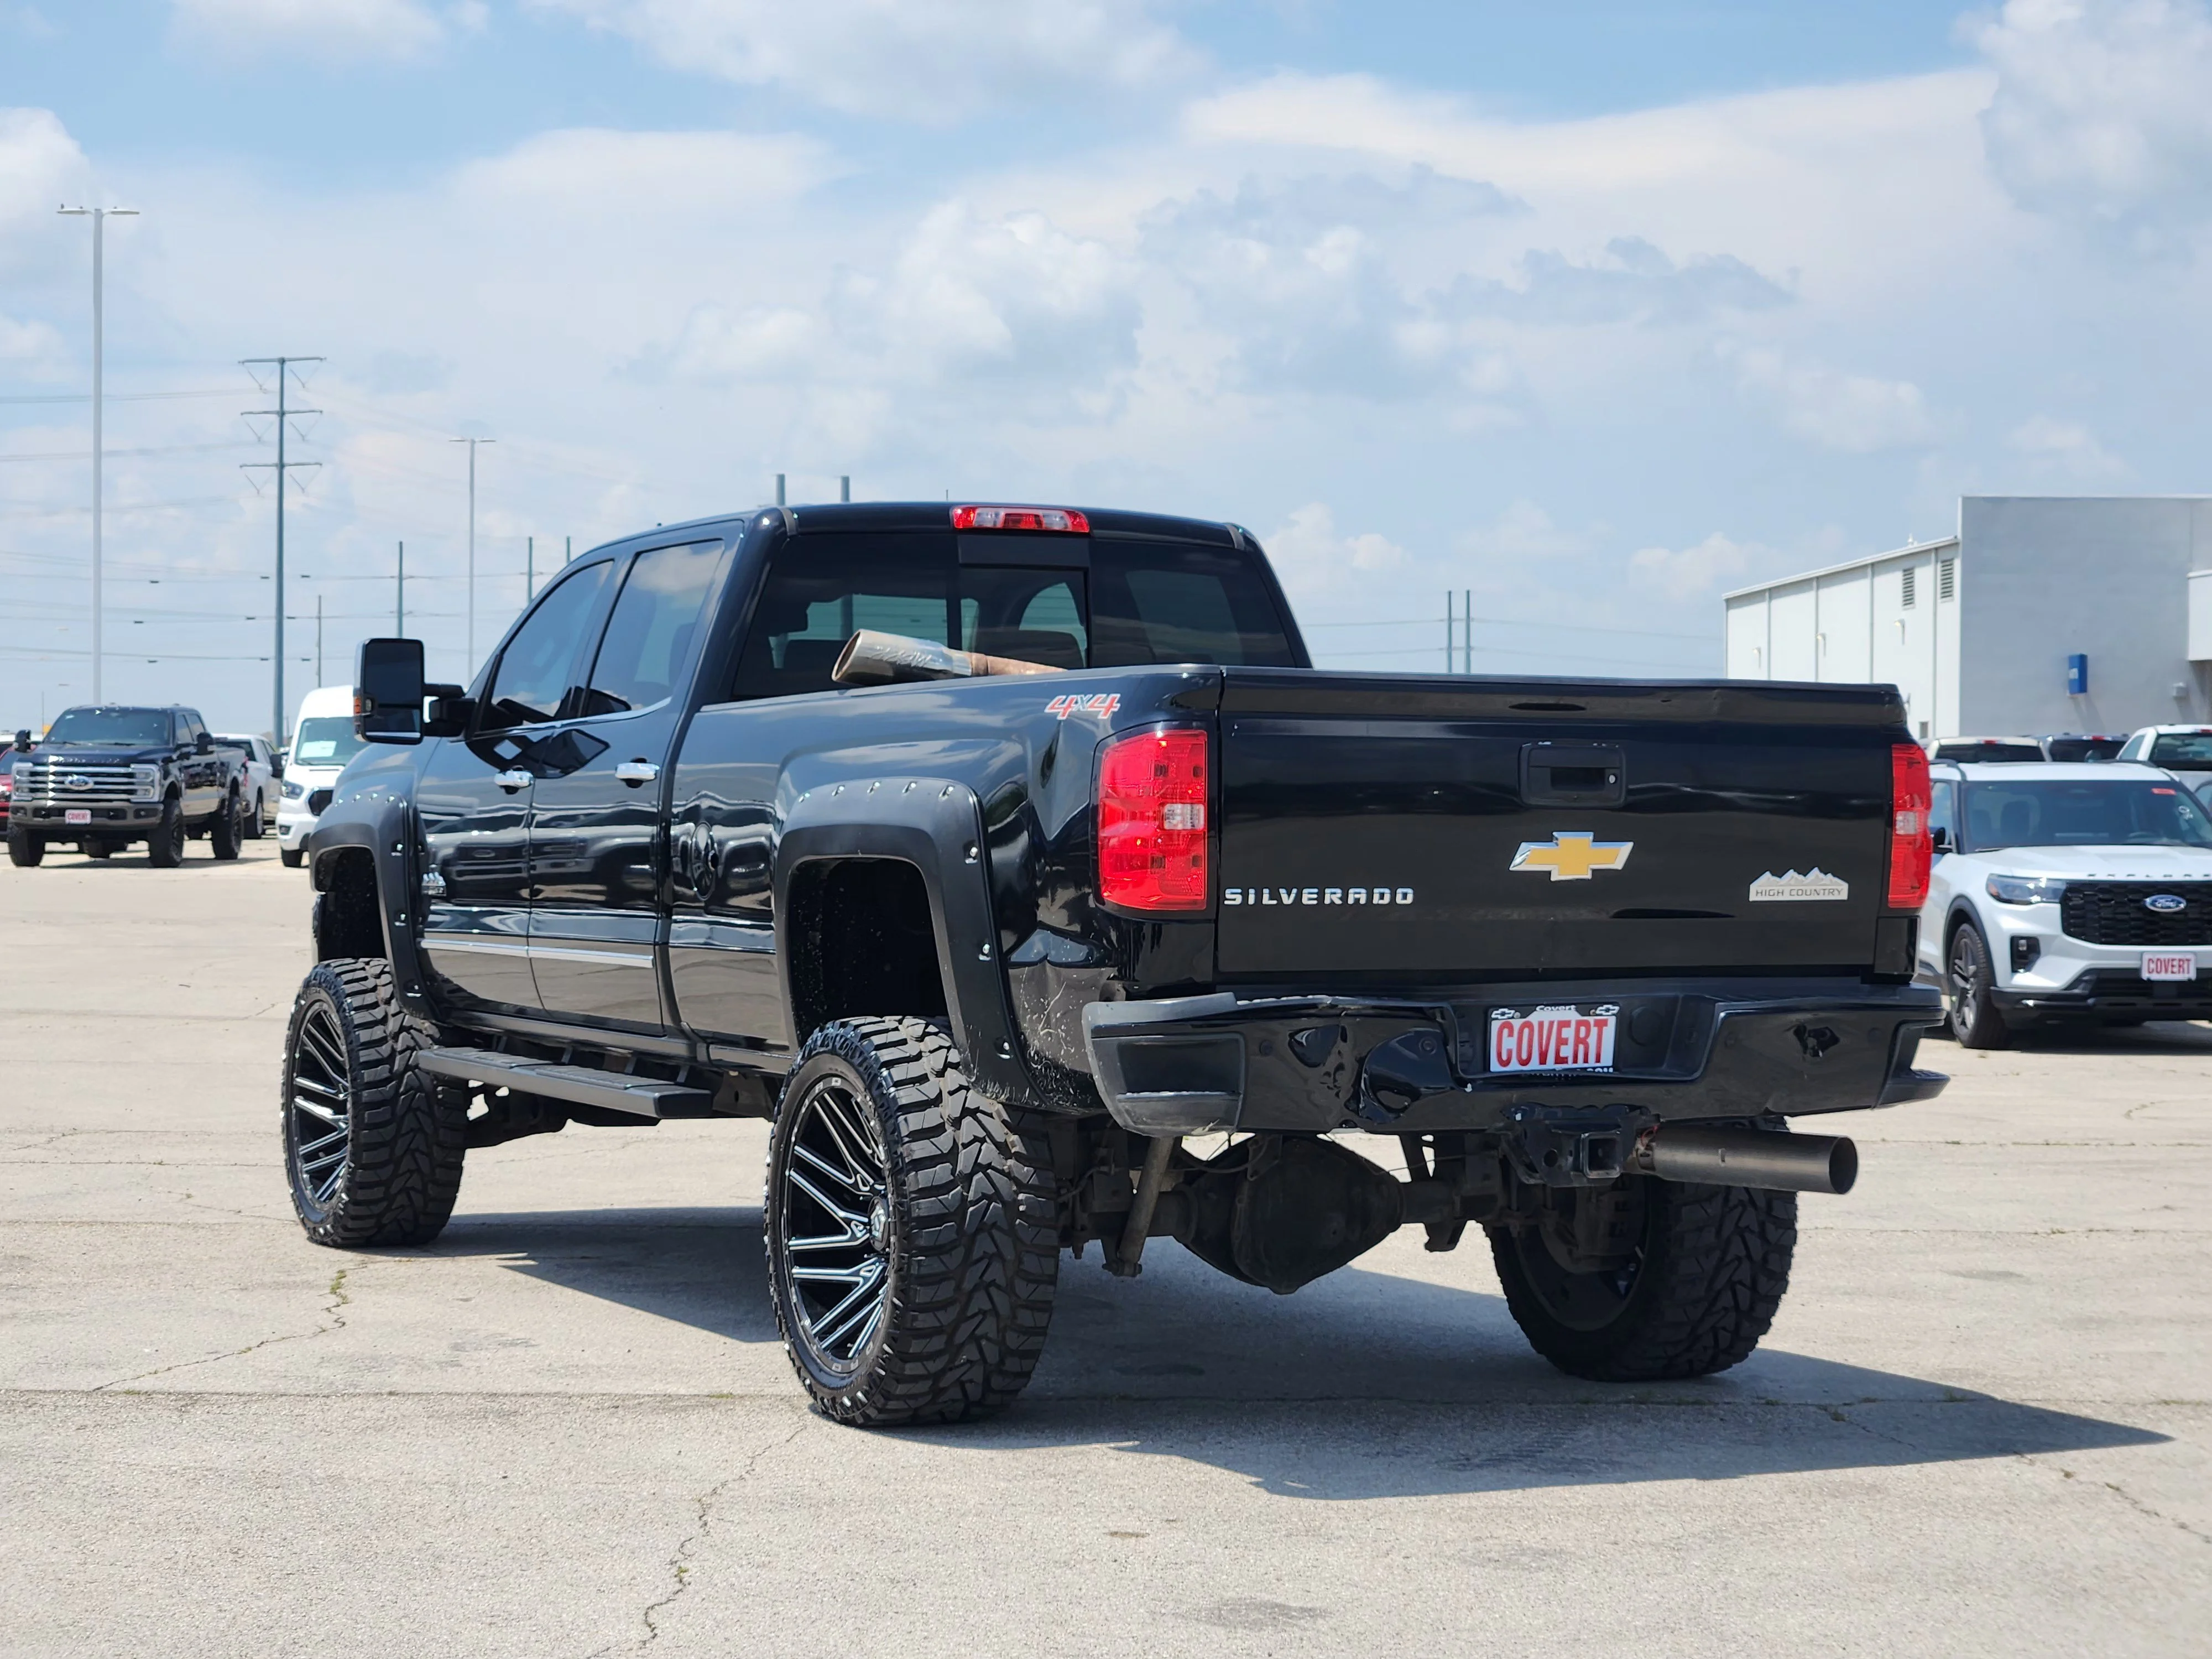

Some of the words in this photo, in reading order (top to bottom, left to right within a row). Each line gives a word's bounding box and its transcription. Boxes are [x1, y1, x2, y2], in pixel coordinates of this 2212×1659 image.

[1224, 888, 1413, 905] SILVERADO
[1755, 888, 1785, 897] HIGH
[1789, 888, 1844, 897] COUNTRY
[2147, 957, 2192, 974] COVERT
[1496, 1018, 1609, 1067] COVERT
